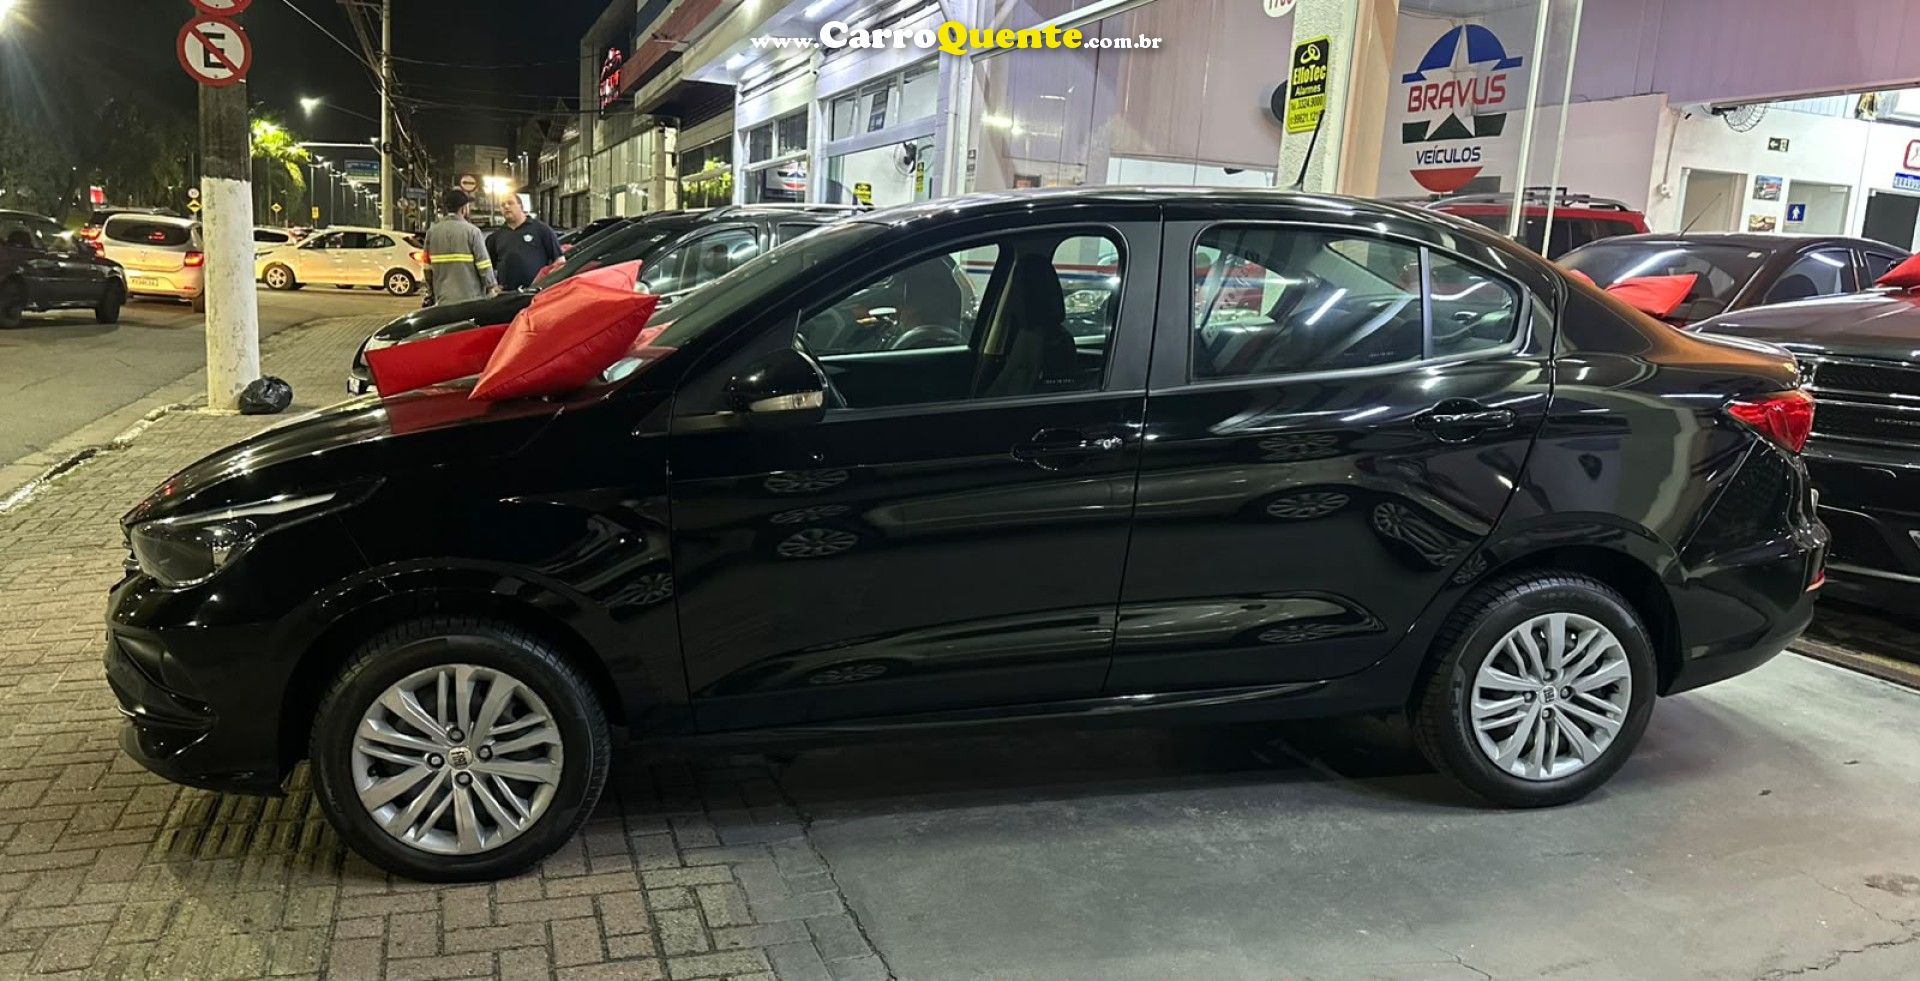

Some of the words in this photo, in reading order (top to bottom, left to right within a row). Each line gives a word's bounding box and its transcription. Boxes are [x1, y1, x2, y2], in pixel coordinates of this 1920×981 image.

[203, 32, 227, 69] E
[1407, 74, 1506, 113] BRAVUS
[1416, 144, 1481, 165] VEÍCULOS
